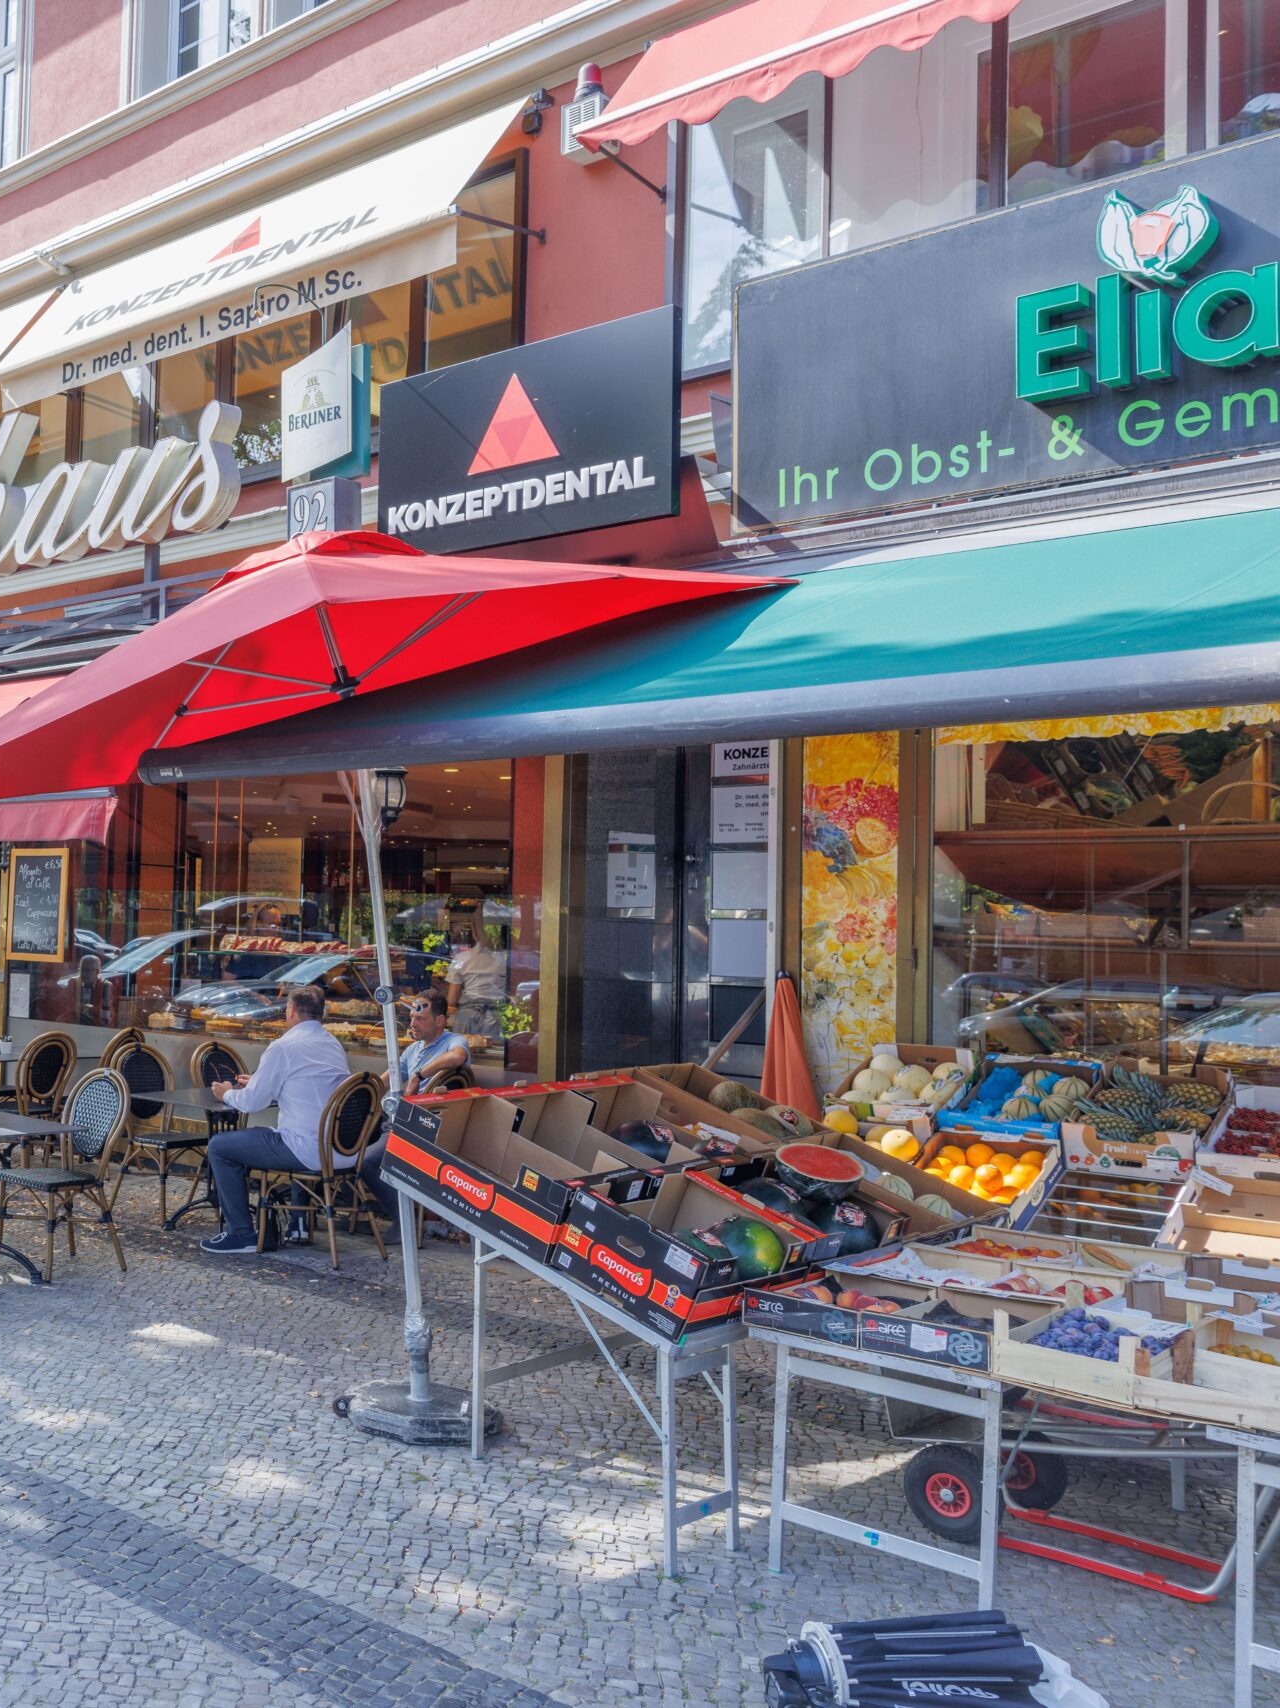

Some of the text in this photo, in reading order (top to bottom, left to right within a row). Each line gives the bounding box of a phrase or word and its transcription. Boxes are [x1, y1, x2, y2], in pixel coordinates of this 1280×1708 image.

[64, 205, 378, 336] KONZEPTDENTAL
[61, 268, 363, 385] Dr. med. dent. I. Sapiro M.Sc.
[288, 404, 342, 433] BERLINER
[778, 387, 1279, 508] Ihr Obst- & Gem
[293, 490, 329, 534] 92
[387, 456, 656, 536] KONZEPTDENTAL
[723, 746, 769, 761] KONZE
[441, 1191, 482, 1219] PREMIUM
[591, 1272, 636, 1305] PREMIUM
